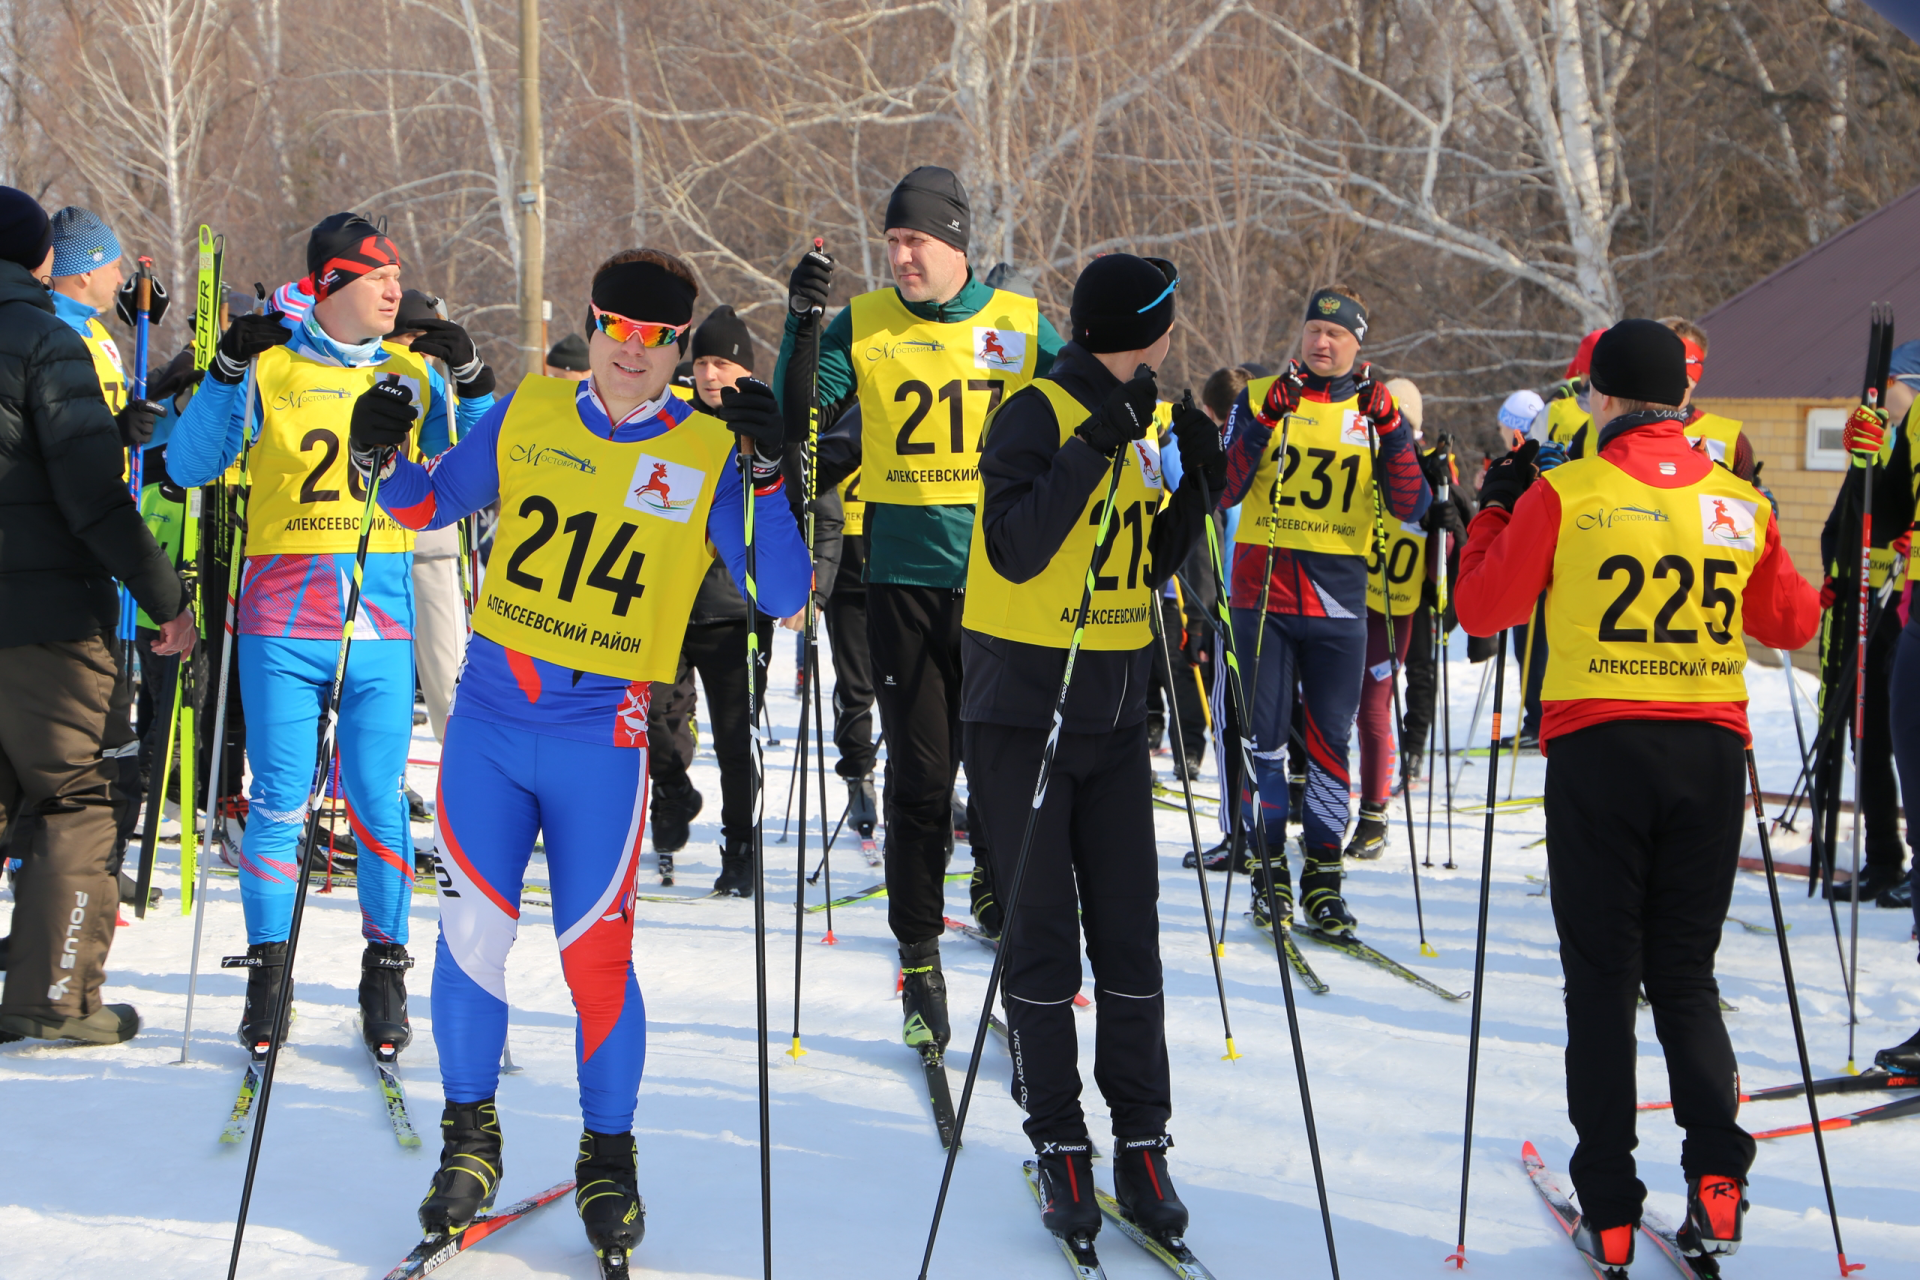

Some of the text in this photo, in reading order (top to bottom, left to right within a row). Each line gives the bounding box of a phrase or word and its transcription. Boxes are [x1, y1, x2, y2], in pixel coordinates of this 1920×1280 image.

[378, 384, 403, 397] LEKI
[809, 407, 819, 453] LEKI
[893, 379, 1005, 455] 217
[1125, 402, 1140, 428] SPORT
[1223, 403, 1239, 450] NORD
[1856, 410, 1877, 425] LEKI
[886, 465, 979, 483] АЛЕКСЕЕВСКИЙ
[1269, 445, 1361, 513] 231
[285, 515, 385, 531] АЛЕКСЕЕВСИЙ
[1332, 523, 1356, 537] РАЙОН
[506, 495, 645, 617] 214
[1860, 546, 1871, 588] LEKI
[1598, 554, 1738, 645] 225
[487, 593, 641, 654] АЛЕКСЕЕВСКИЙ РАЙОН
[1589, 658, 1708, 676] АЛЕКСЕЕВСКИЙ
[309, 876, 358, 888] FISCHE
[60, 891, 89, 969] POLUS
[902, 965, 933, 974] SCHER
[1013, 1029, 1026, 1084] VICTORY
[1887, 1077, 1919, 1087] ATOMIC
[1119, 1220, 1149, 1249] FISCHER
[423, 1239, 460, 1276] ROSSIGNOL
